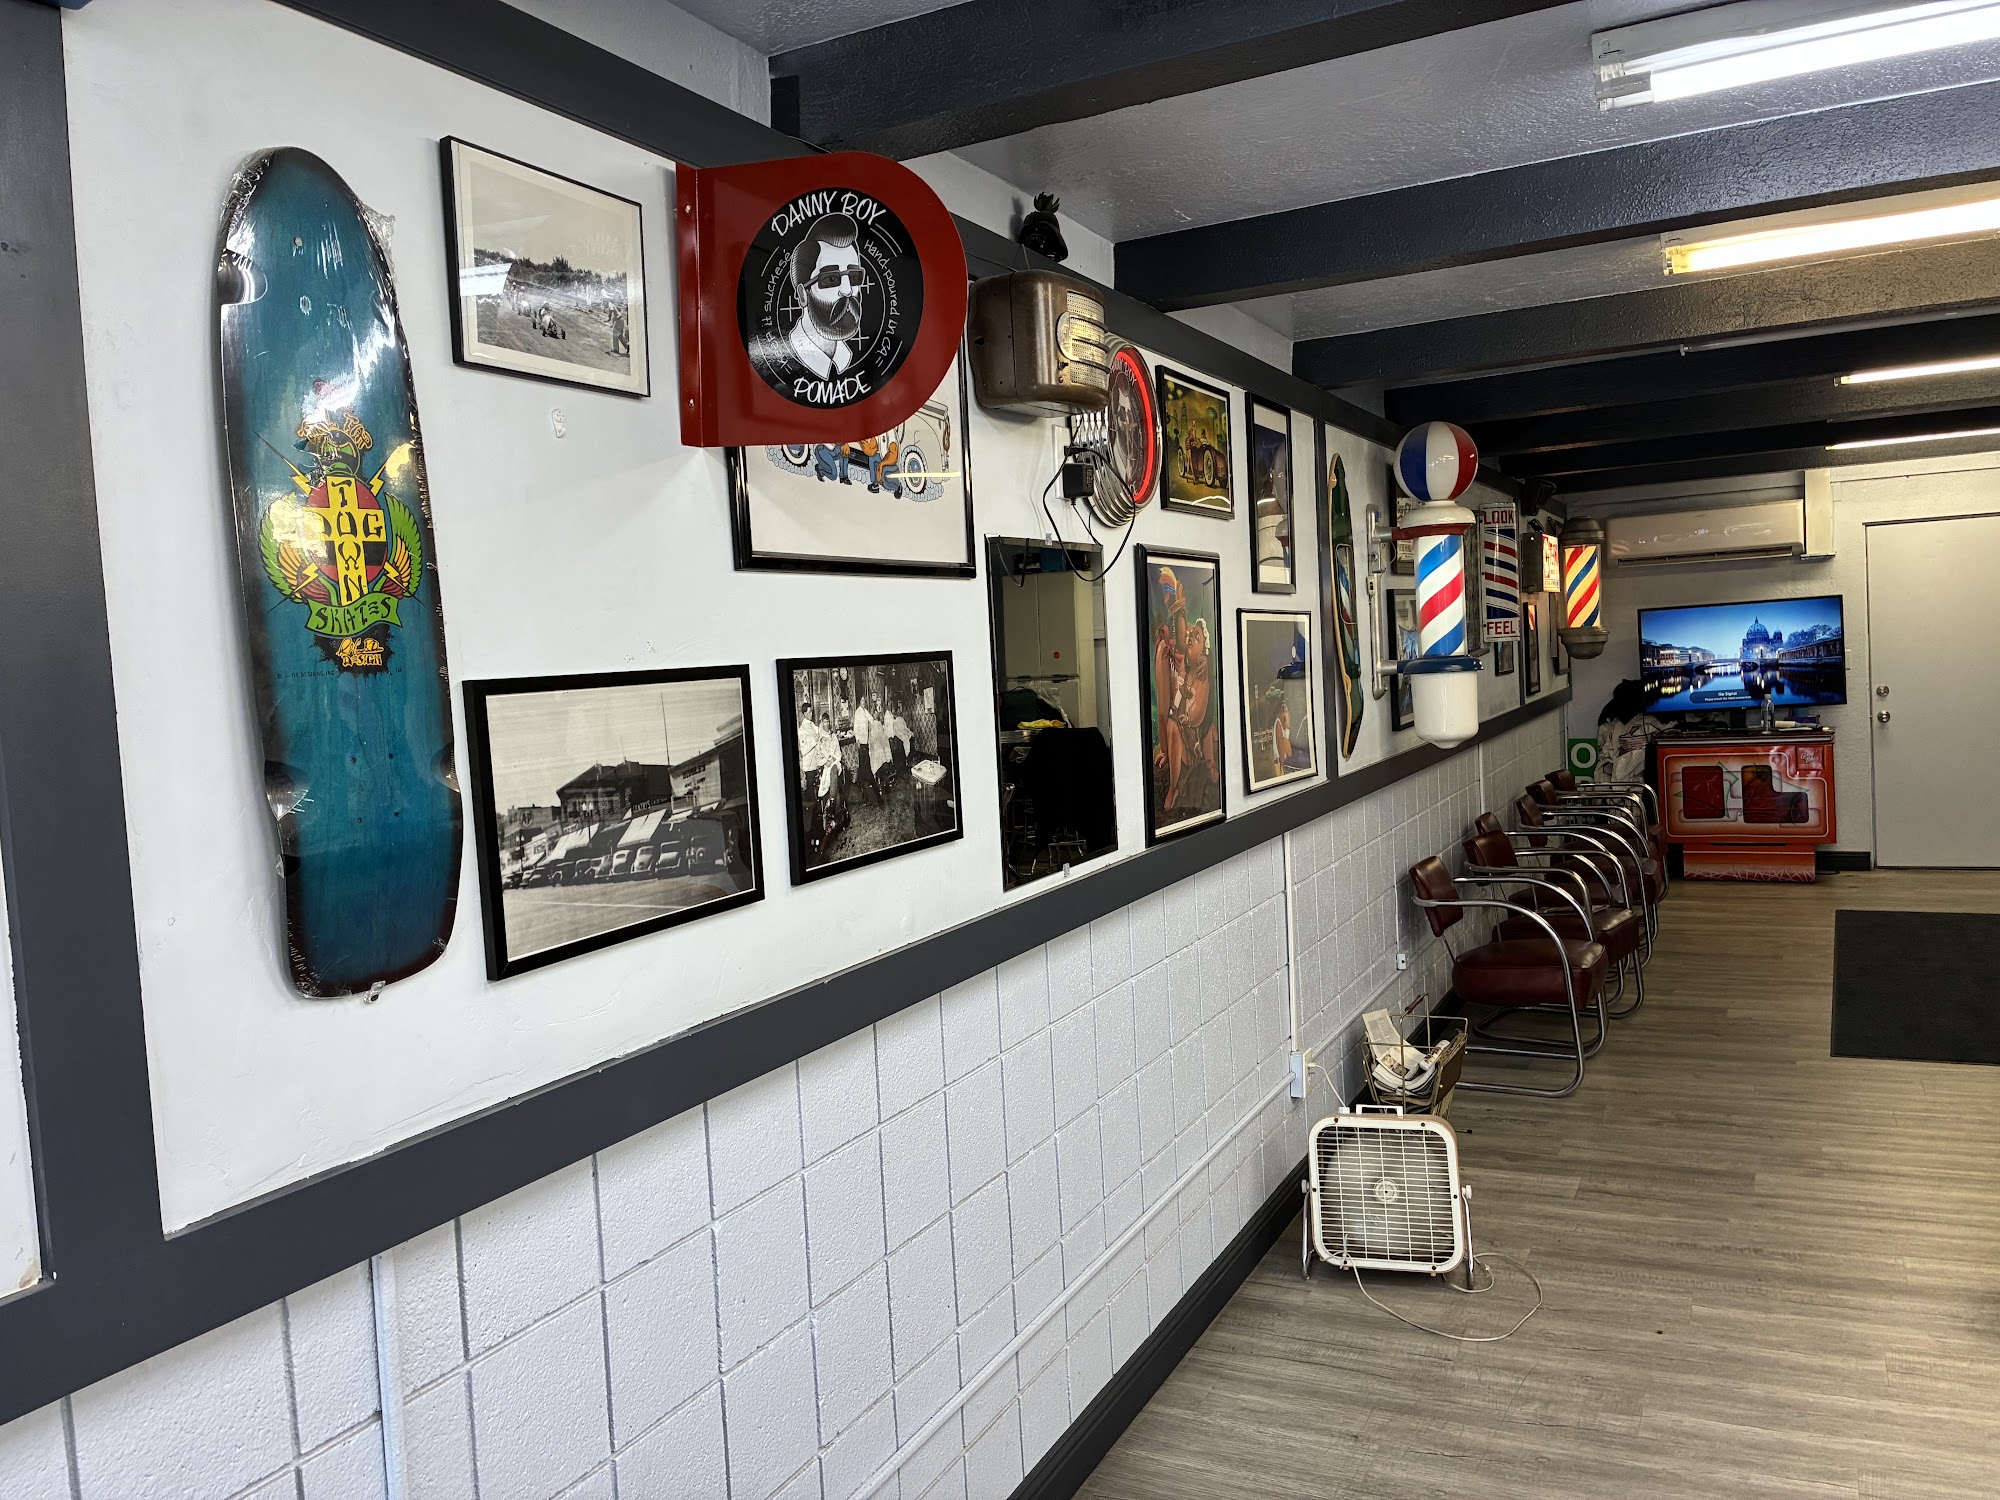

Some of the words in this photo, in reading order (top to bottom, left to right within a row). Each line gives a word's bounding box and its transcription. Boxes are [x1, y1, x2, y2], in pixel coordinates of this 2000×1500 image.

[771, 190, 838, 237] DANNY
[841, 191, 887, 226] BOY
[761, 315, 773, 328] it
[793, 369, 872, 405] POMADE
[1483, 510, 1515, 525] LOOK
[314, 596, 392, 635] SKATES
[1486, 620, 1516, 636] FEEL
[341, 653, 383, 668] DESIGN
